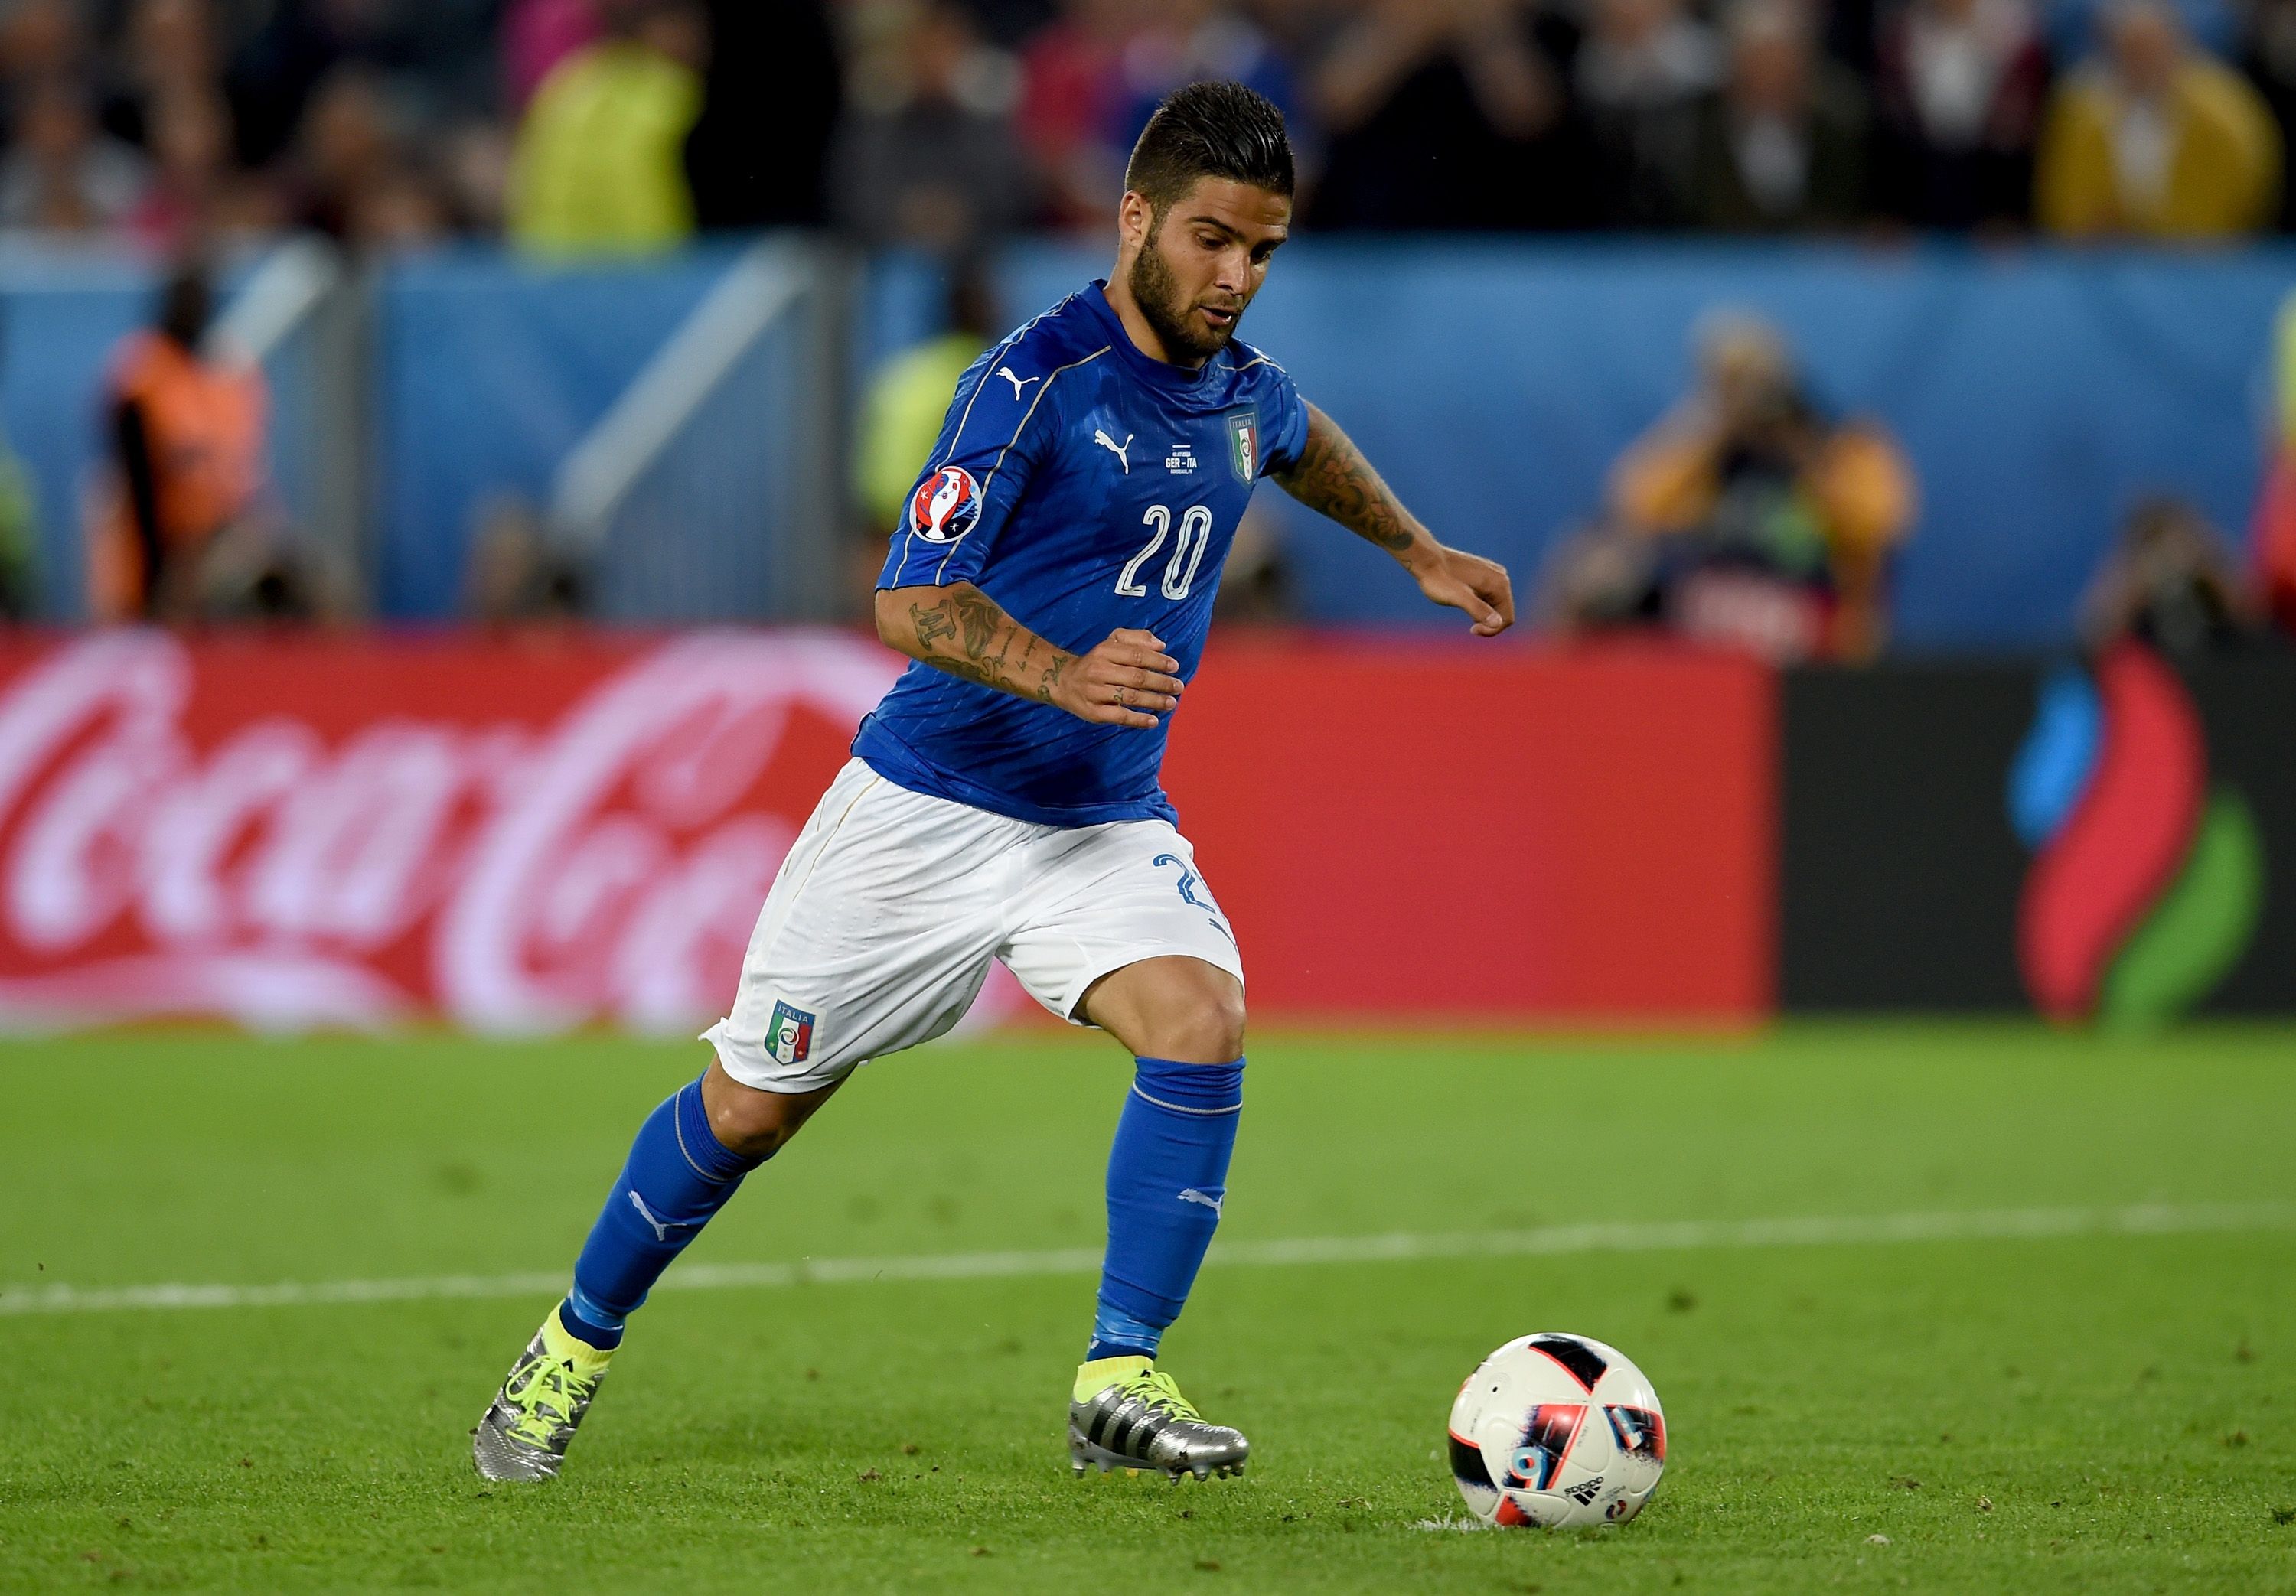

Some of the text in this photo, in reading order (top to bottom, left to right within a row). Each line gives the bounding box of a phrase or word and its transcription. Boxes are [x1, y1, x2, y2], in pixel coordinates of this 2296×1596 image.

[1232, 419, 1252, 428] ITALIA
[1165, 457, 1181, 468] GER
[1186, 457, 1198, 468] ITA
[1114, 505, 1212, 600] 20
[778, 1004, 808, 1023] ITALIA
[1564, 1476, 1604, 1496] adidas
